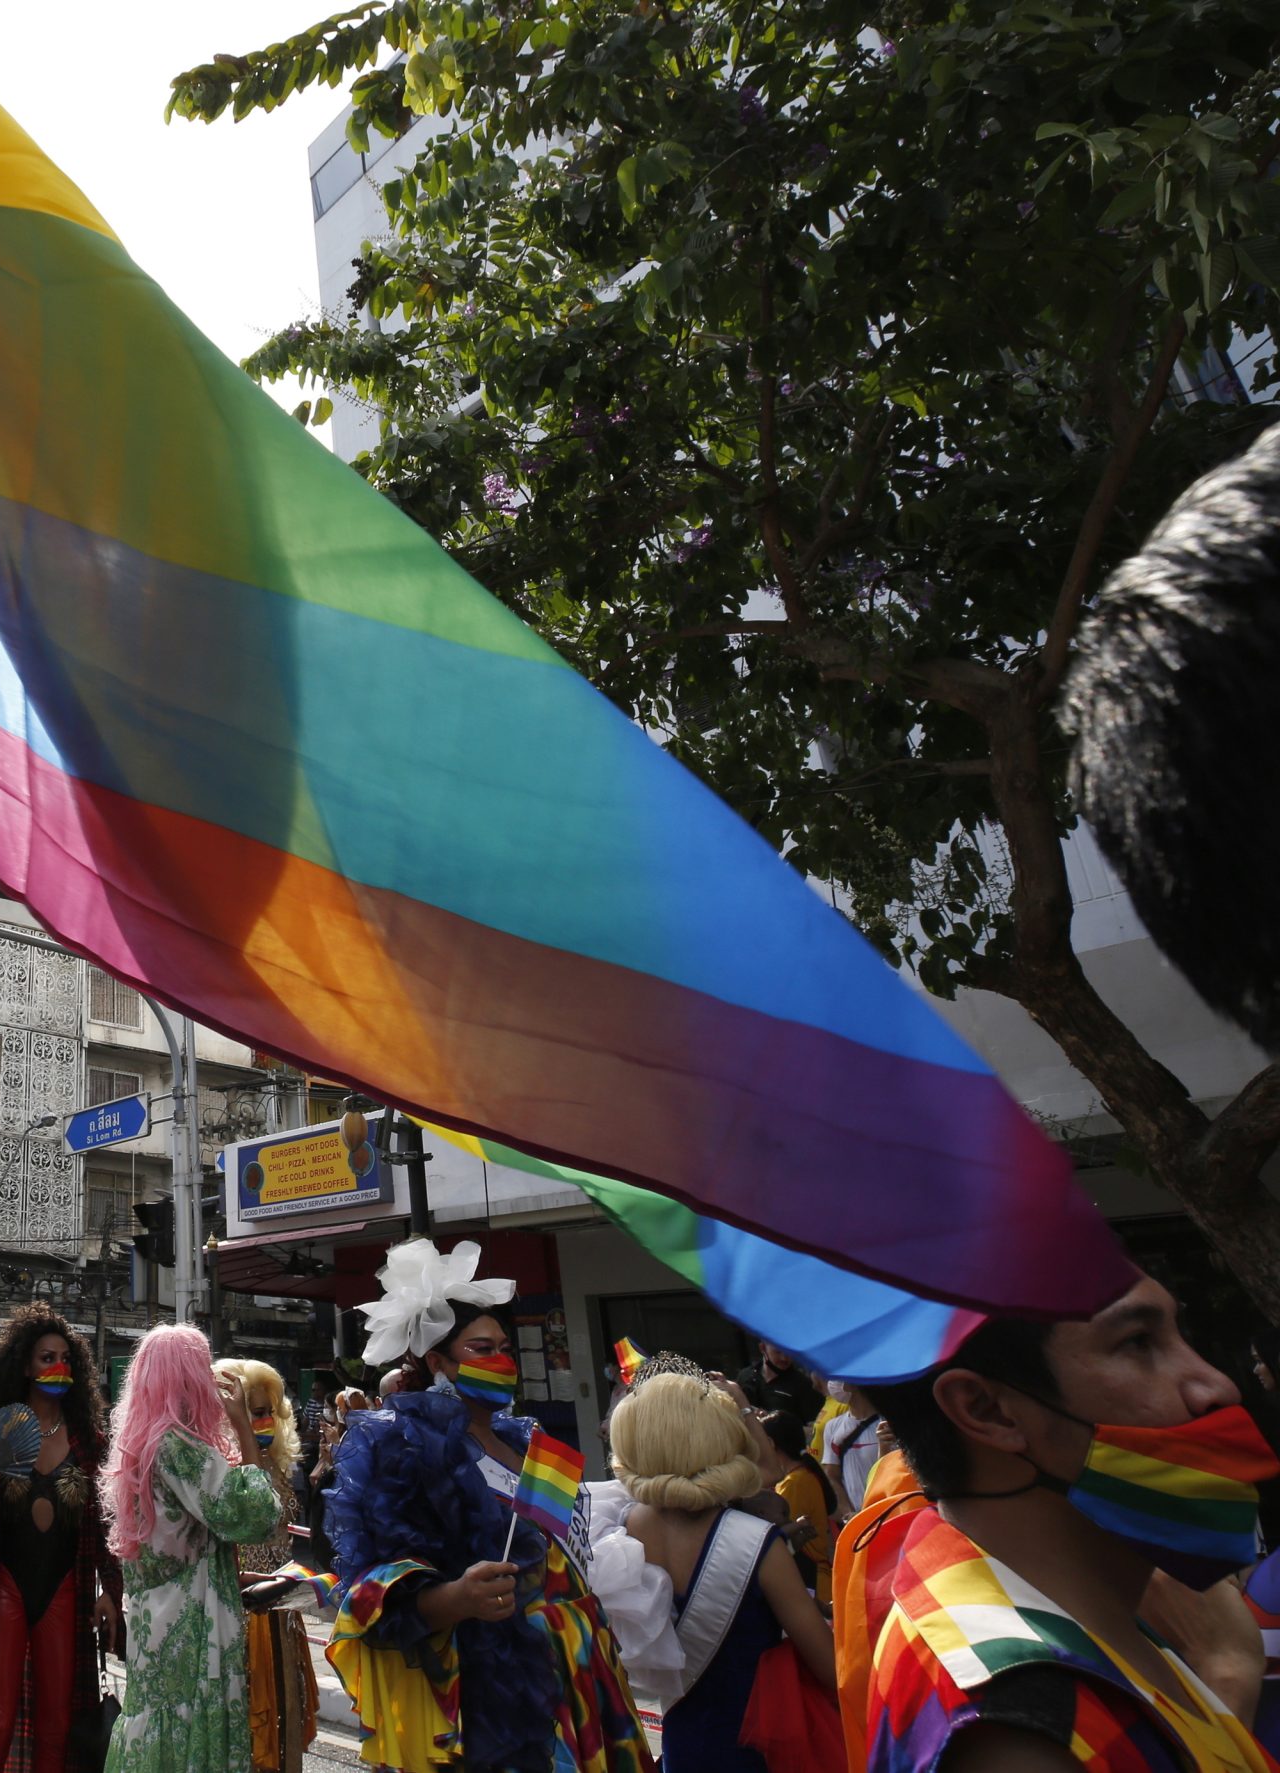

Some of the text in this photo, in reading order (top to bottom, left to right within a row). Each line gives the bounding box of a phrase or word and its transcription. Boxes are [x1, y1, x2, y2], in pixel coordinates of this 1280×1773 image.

[89, 1108, 120, 1133] ถ.สีลม
[86, 1135, 93, 1144] Si
[96, 1133, 110, 1142] Lom
[271, 1139, 339, 1160] BURGERS HOT DOGS
[268, 1151, 342, 1172] CHILI PIZZA MEXICAN
[277, 1167, 334, 1183] ICE COLD DRINKS
[266, 1177, 349, 1199] FRESHLY BREWED COFFEE
[244, 1209, 259, 1217] GOOD
[258, 1207, 272, 1215] FOOD
[272, 1205, 284, 1213] AND
[283, 1201, 308, 1211] FRIENDLY
[308, 1198, 330, 1208] SERVICE
[343, 1194, 361, 1202] GOOD
[360, 1191, 378, 1200] PRICE
